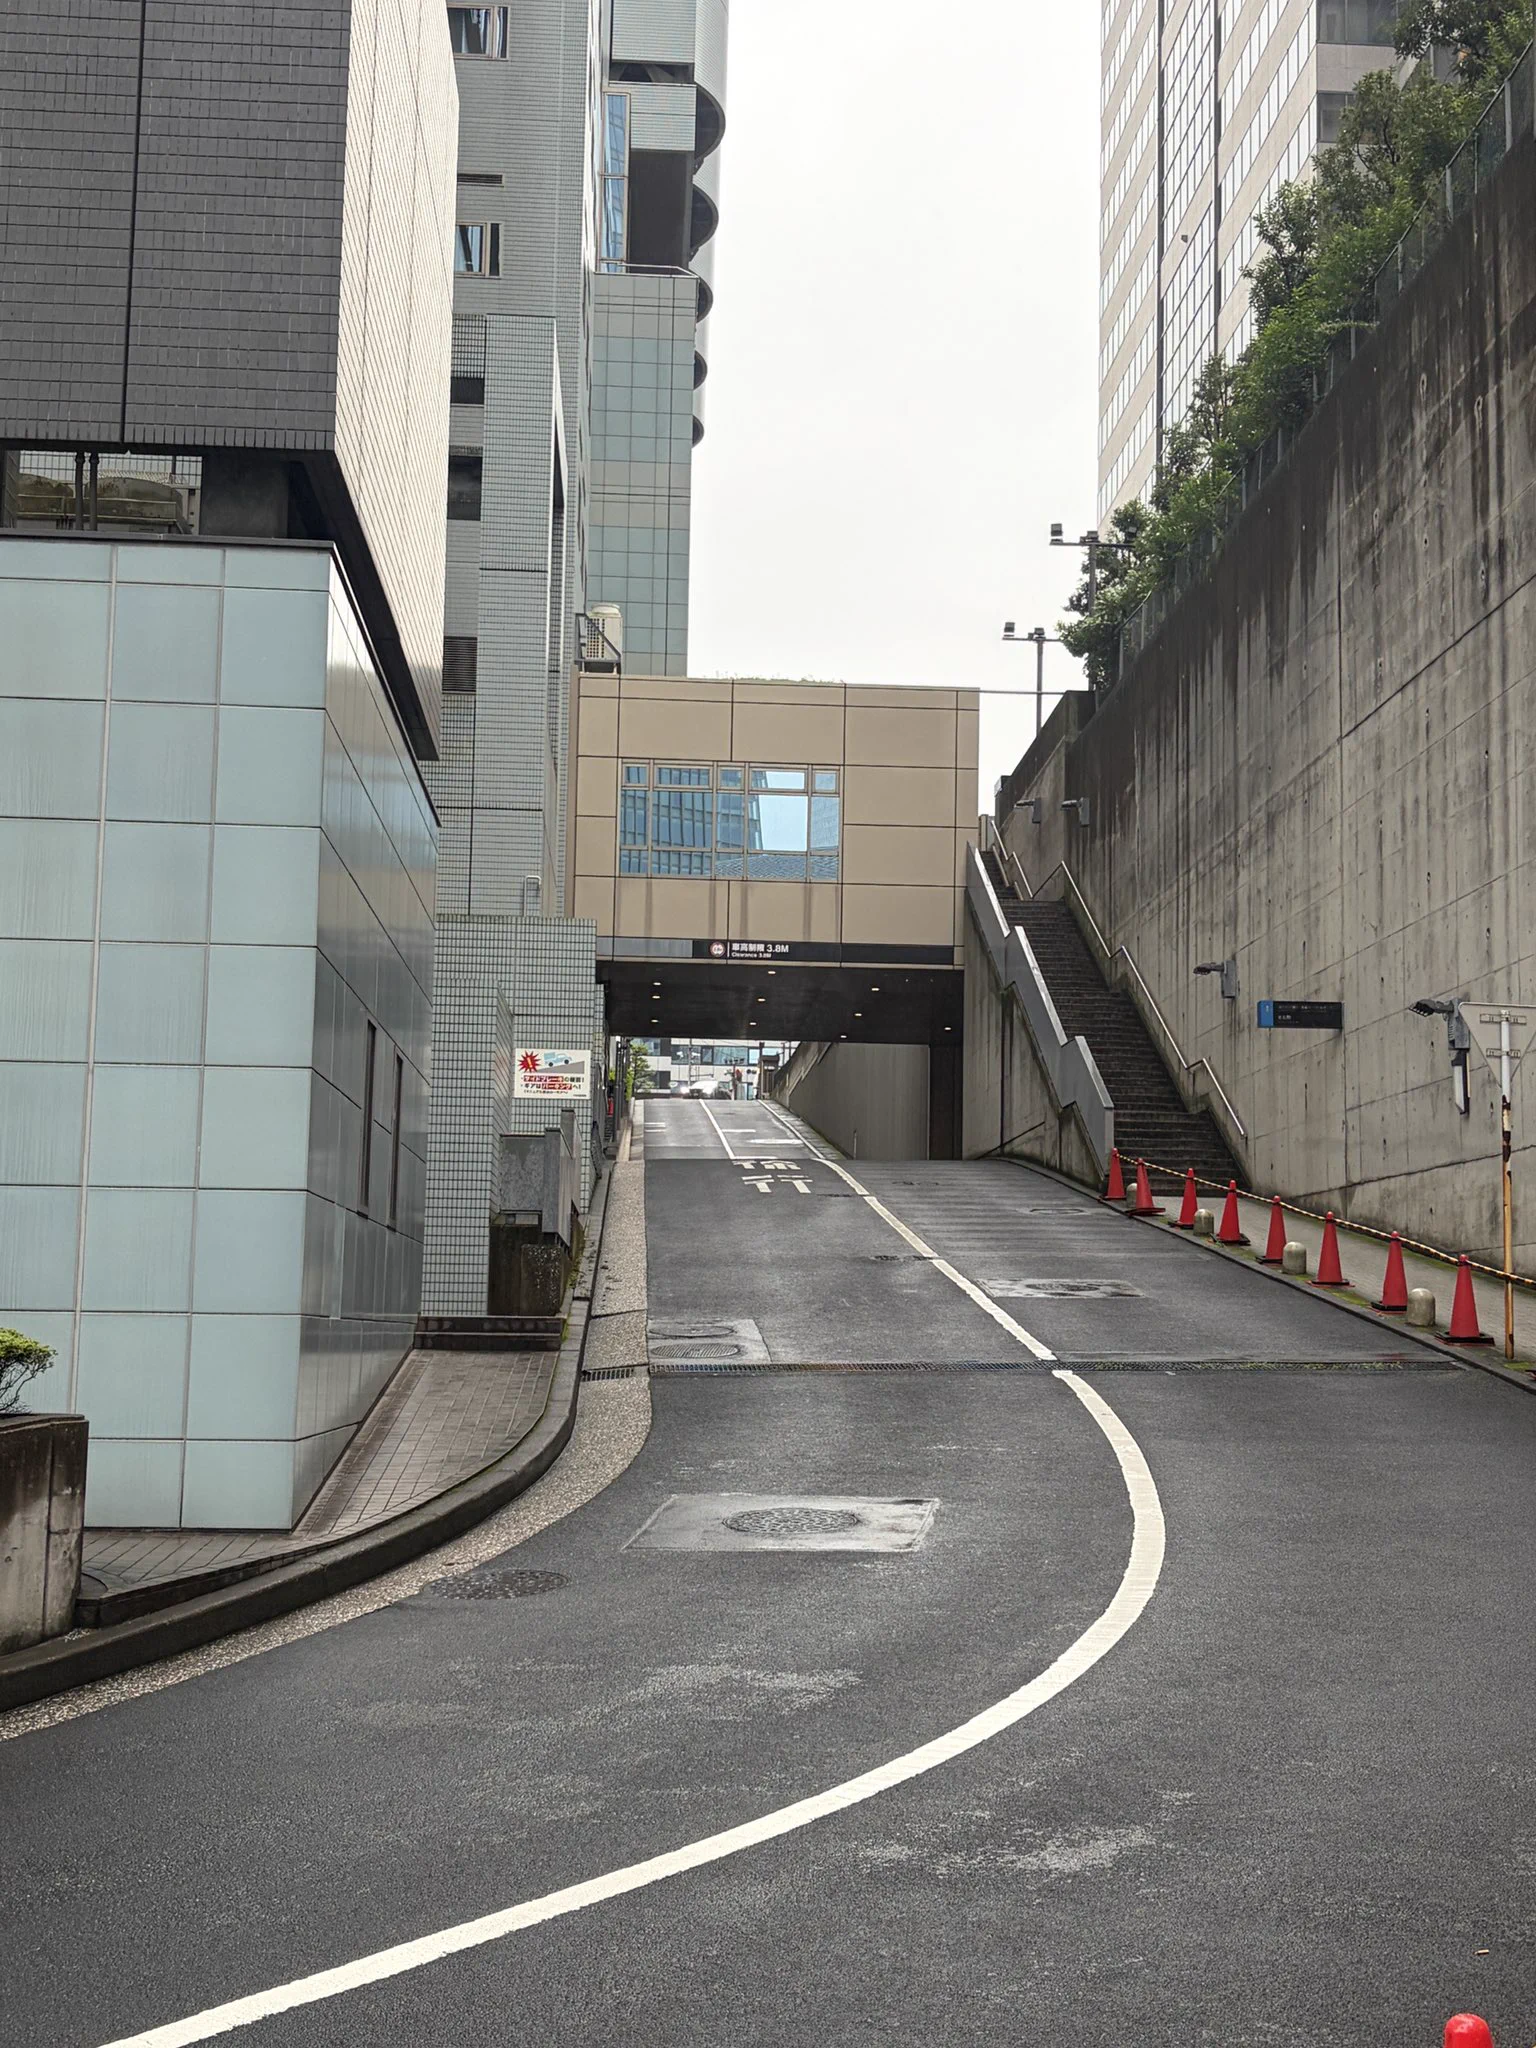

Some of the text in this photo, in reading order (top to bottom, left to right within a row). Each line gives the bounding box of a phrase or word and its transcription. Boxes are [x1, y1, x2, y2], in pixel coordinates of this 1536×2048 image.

[731, 942, 765, 952] 車高制限
[766, 944, 789, 953] 3.8M
